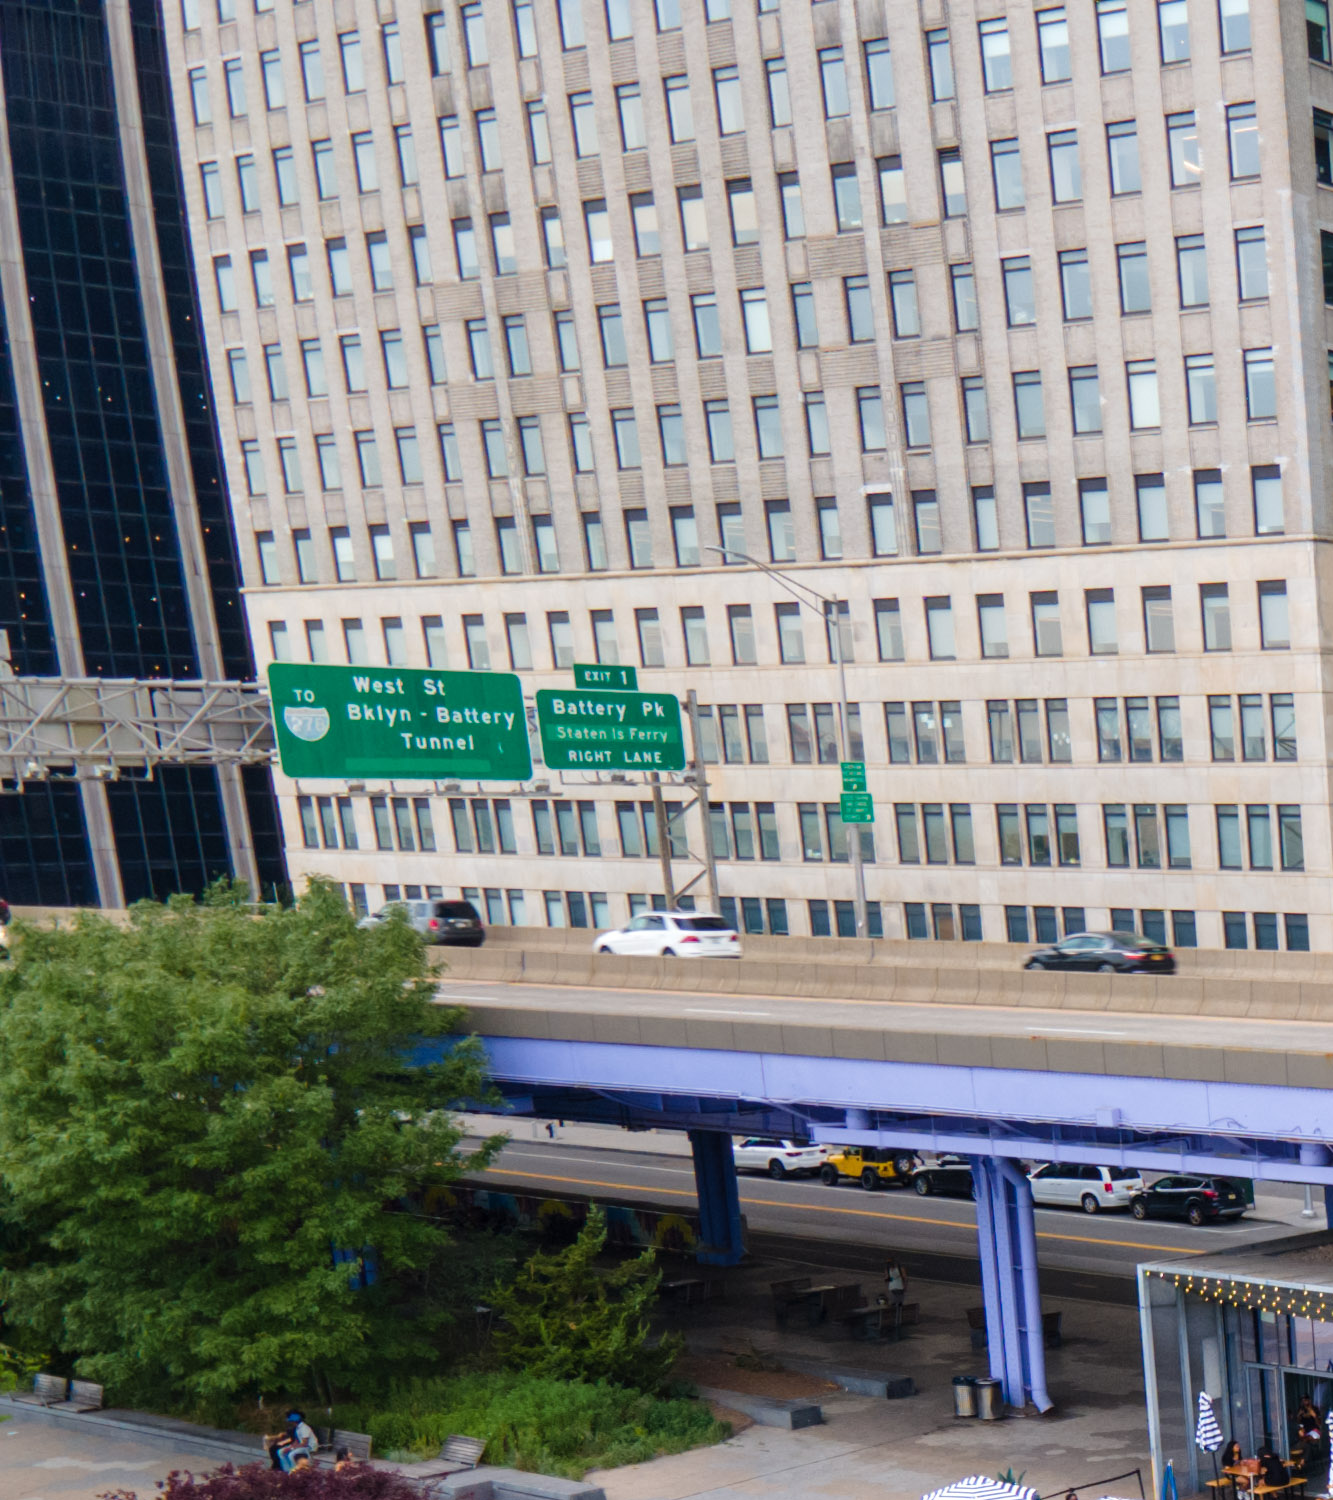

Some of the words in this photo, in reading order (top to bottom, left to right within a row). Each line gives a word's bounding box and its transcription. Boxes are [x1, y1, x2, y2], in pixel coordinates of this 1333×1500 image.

[353, 676, 405, 695] West
[423, 678, 446, 696] St
[584, 670, 611, 682] EXIT
[621, 671, 629, 686] 1
[294, 689, 316, 703] TO
[347, 703, 412, 728] Bklyn
[436, 706, 515, 731] Battery
[552, 698, 627, 721] Battery
[642, 701, 666, 717] Pk
[400, 732, 475, 751] Tunnel
[557, 726, 607, 740] Staten
[612, 727, 625, 741] Is
[629, 727, 669, 744] Ferry
[568, 750, 612, 762] RIGHT
[624, 751, 662, 764] LANE
